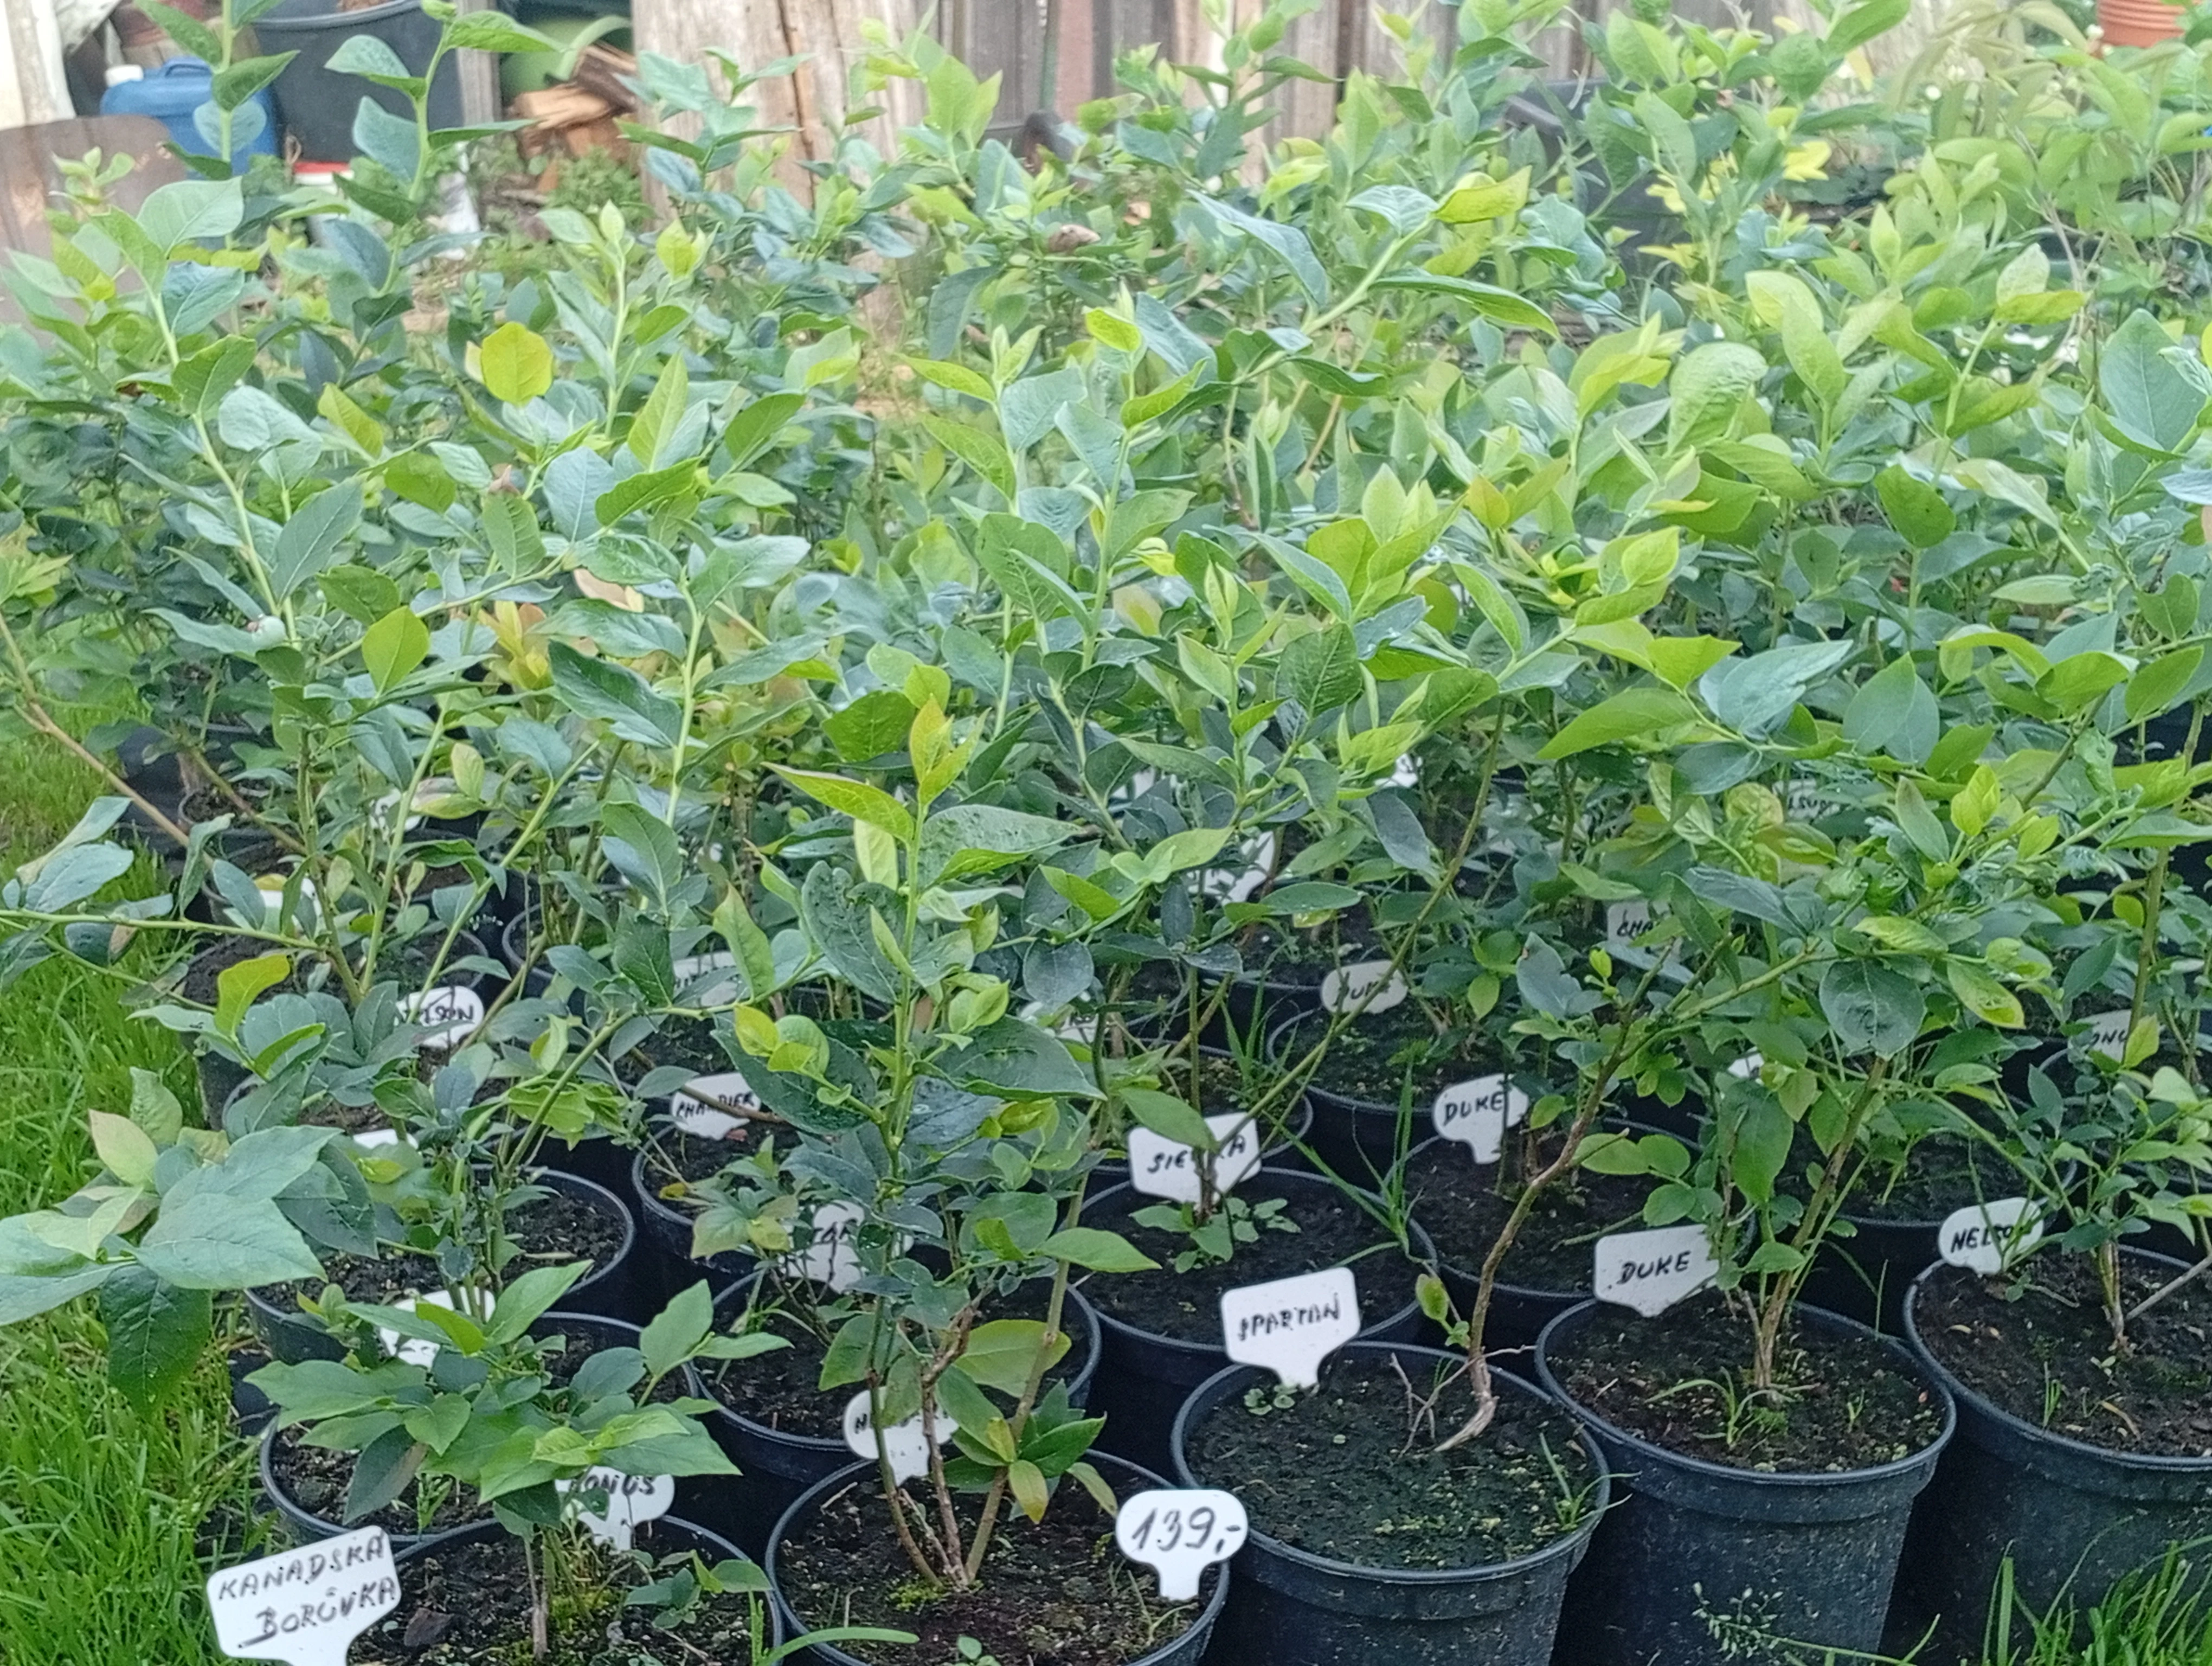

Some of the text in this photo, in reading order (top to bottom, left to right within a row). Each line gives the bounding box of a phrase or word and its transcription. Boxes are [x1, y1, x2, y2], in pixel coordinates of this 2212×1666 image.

[1443, 1091, 1505, 1126] DUKE
[1147, 1135, 1246, 1173] SIEA
[1616, 1250, 1691, 1285] DUKE
[1238, 1292, 1340, 1342] SPARTAN
